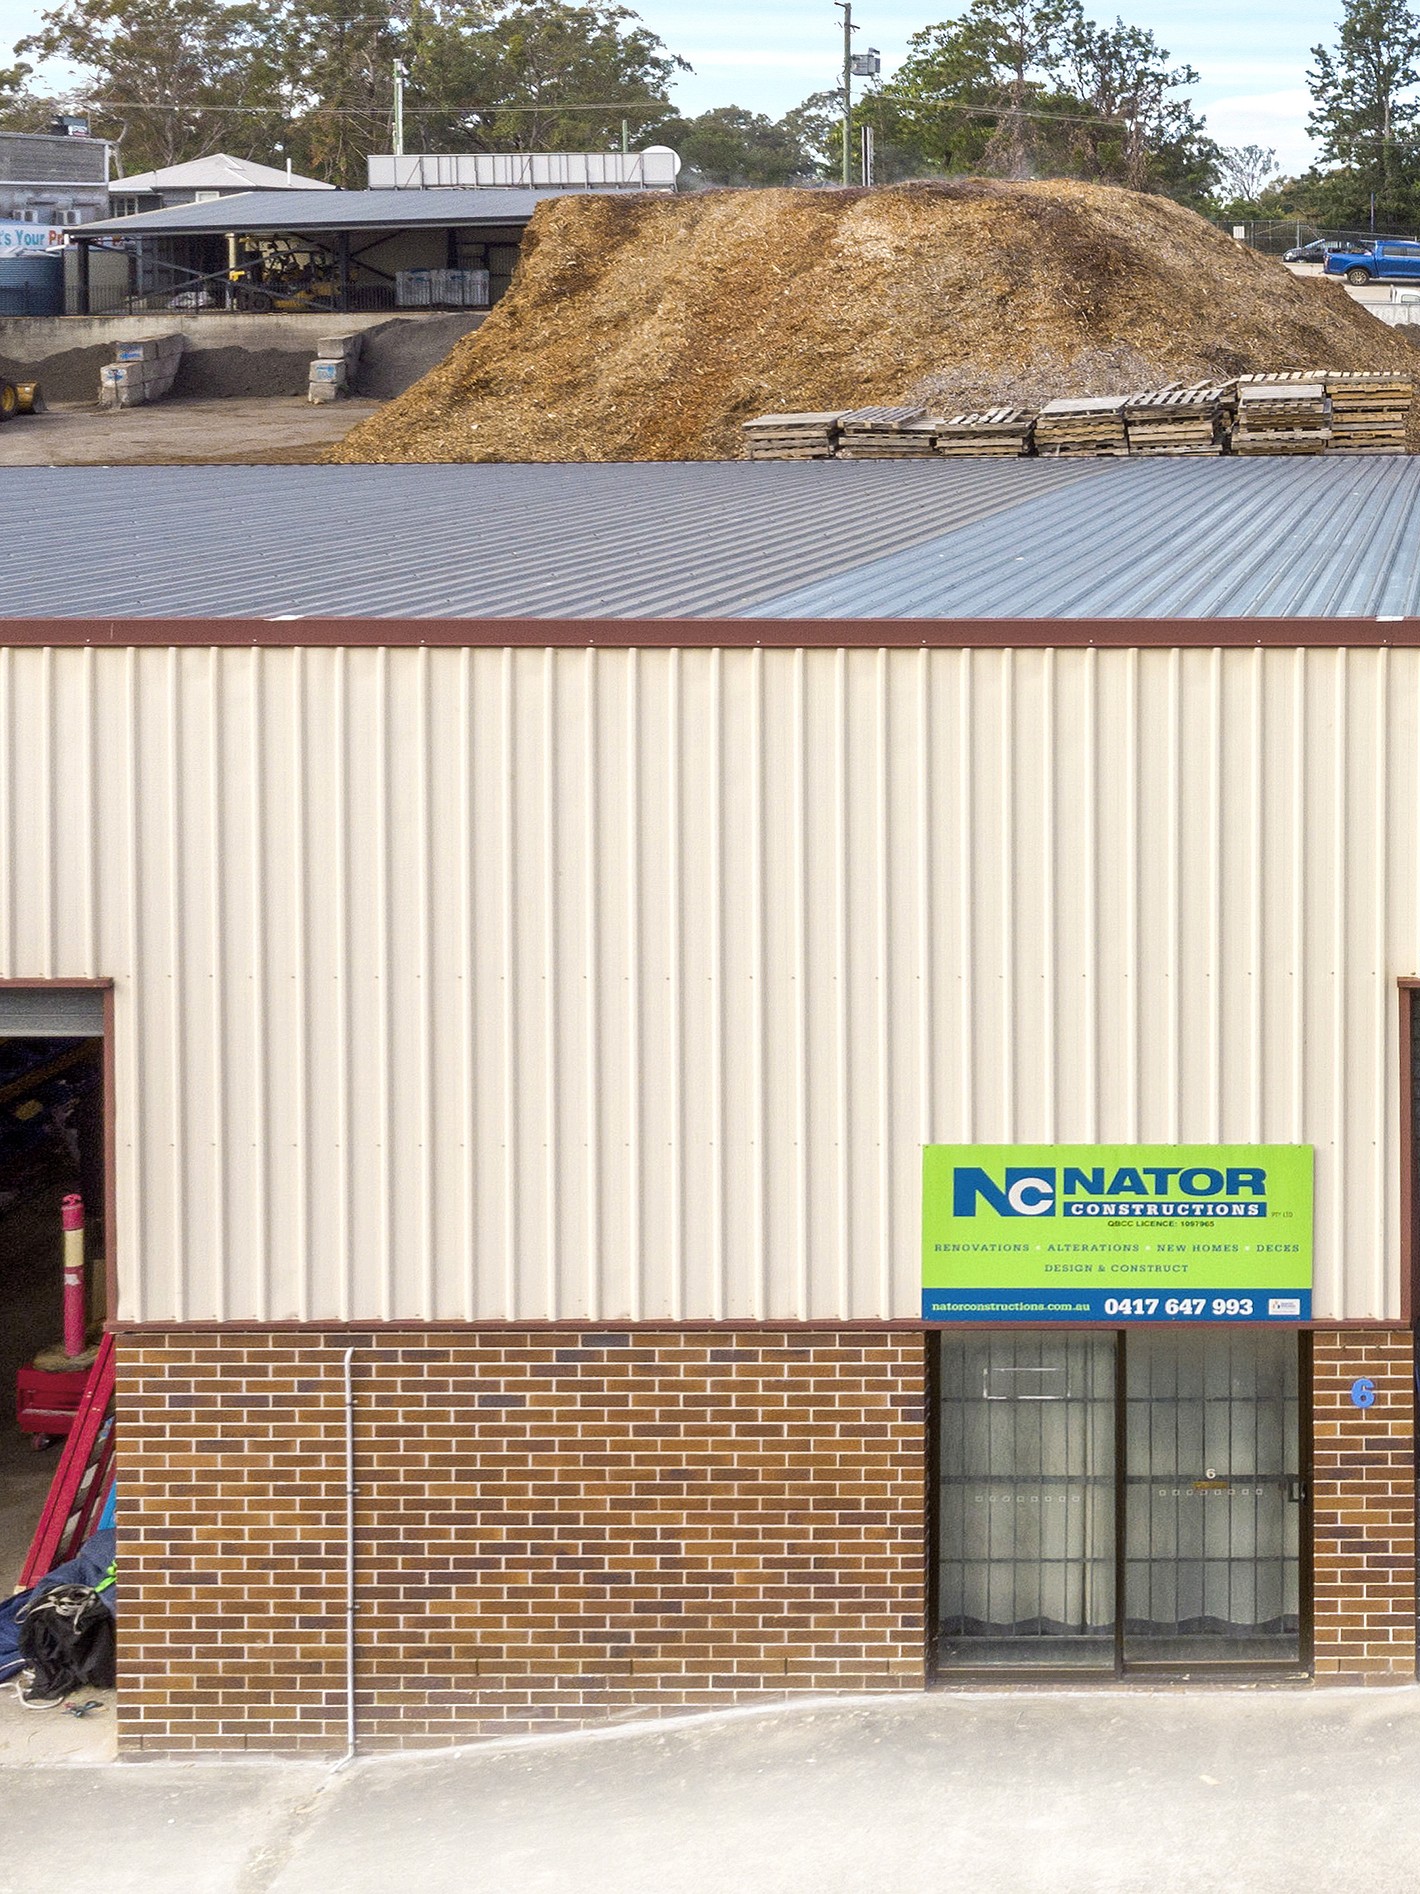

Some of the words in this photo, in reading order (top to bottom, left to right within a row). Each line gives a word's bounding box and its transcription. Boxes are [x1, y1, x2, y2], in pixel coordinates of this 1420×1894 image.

[15, 229, 45, 246] Your
[1063, 1167, 1268, 1196] NATOR
[953, 1167, 1057, 1217] NC
[1070, 1203, 1260, 1216] CONSTRUCTIONS
[1107, 1220, 1134, 1228] QBCC
[1135, 1220, 1178, 1228] LICENCE:
[934, 1243, 1030, 1253] RENOVATIONS
[1046, 1243, 1140, 1253] ALTERATIONS
[1156, 1243, 1187, 1253] NEW
[1191, 1243, 1240, 1253] HOMES
[1044, 1263, 1093, 1273] DESIGN
[1097, 1264, 1106, 1273] &
[1110, 1263, 1189, 1273] CONSTRUCT
[931, 1301, 1091, 1312] natorconstructions.com.au
[1104, 1298, 1160, 1315] 0417
[1164, 1298, 1207, 1315] 647
[1212, 1298, 1254, 1315] 993
[1350, 1377, 1375, 1409] 6
[1206, 1467, 1216, 1480] 6
